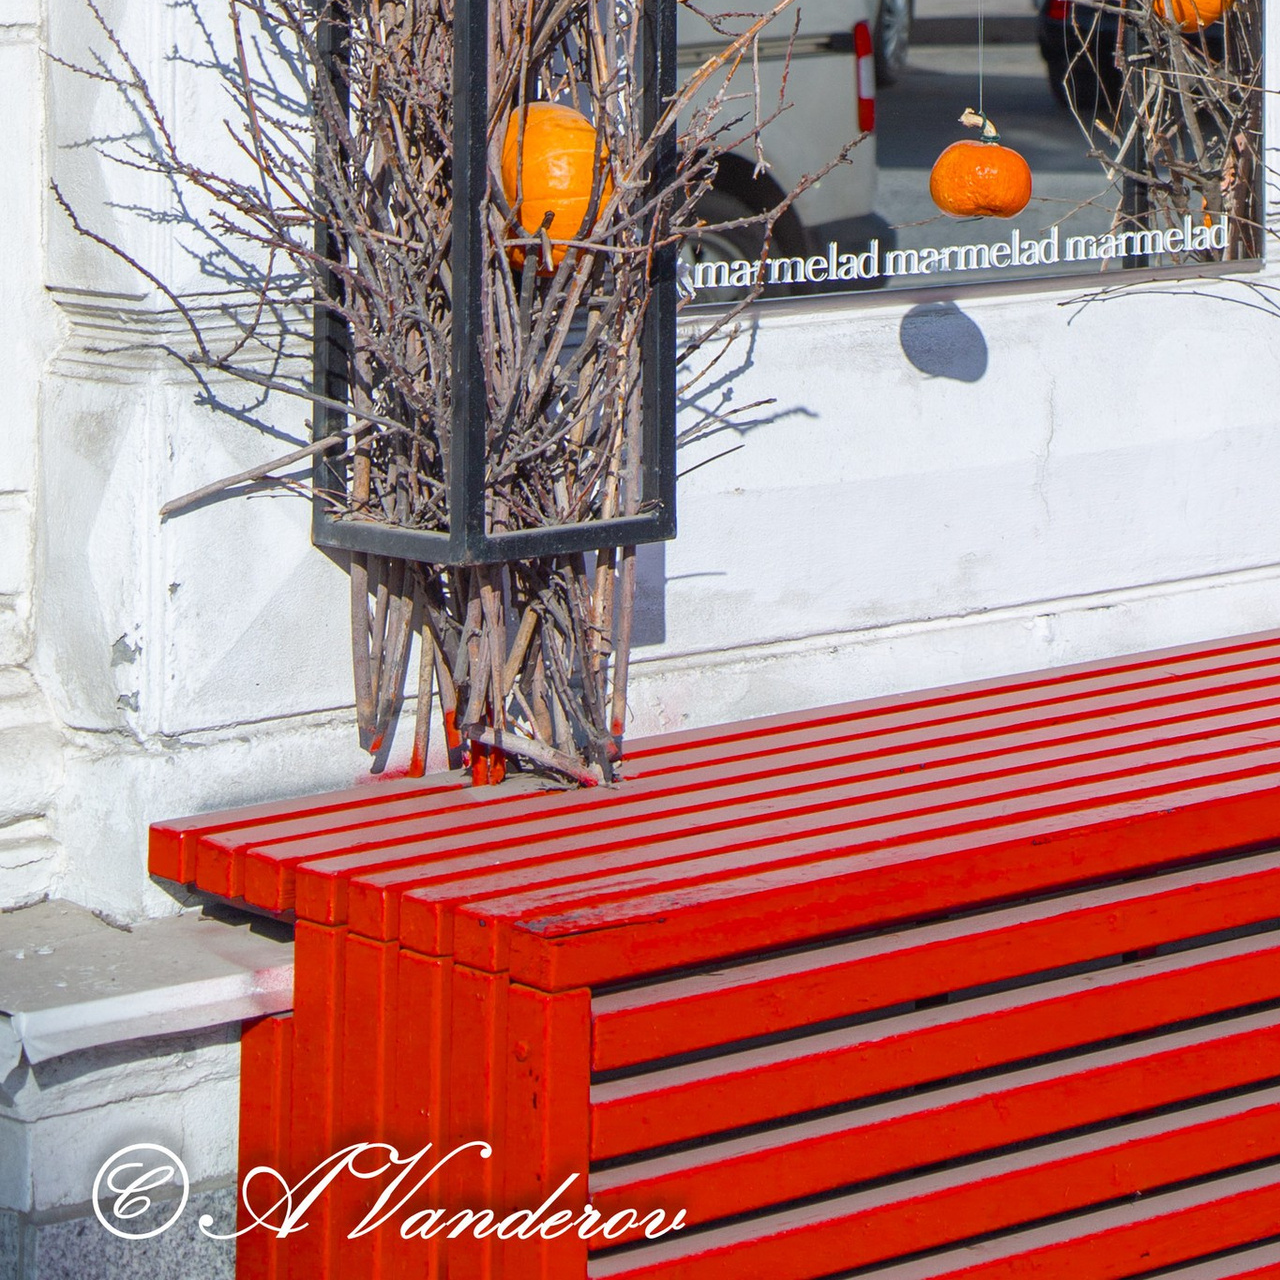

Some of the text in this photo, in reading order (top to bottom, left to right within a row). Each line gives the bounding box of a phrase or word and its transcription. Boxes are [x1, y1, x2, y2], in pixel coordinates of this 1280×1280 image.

[693, 213, 1230, 288] marmelad marmelad marmelad
